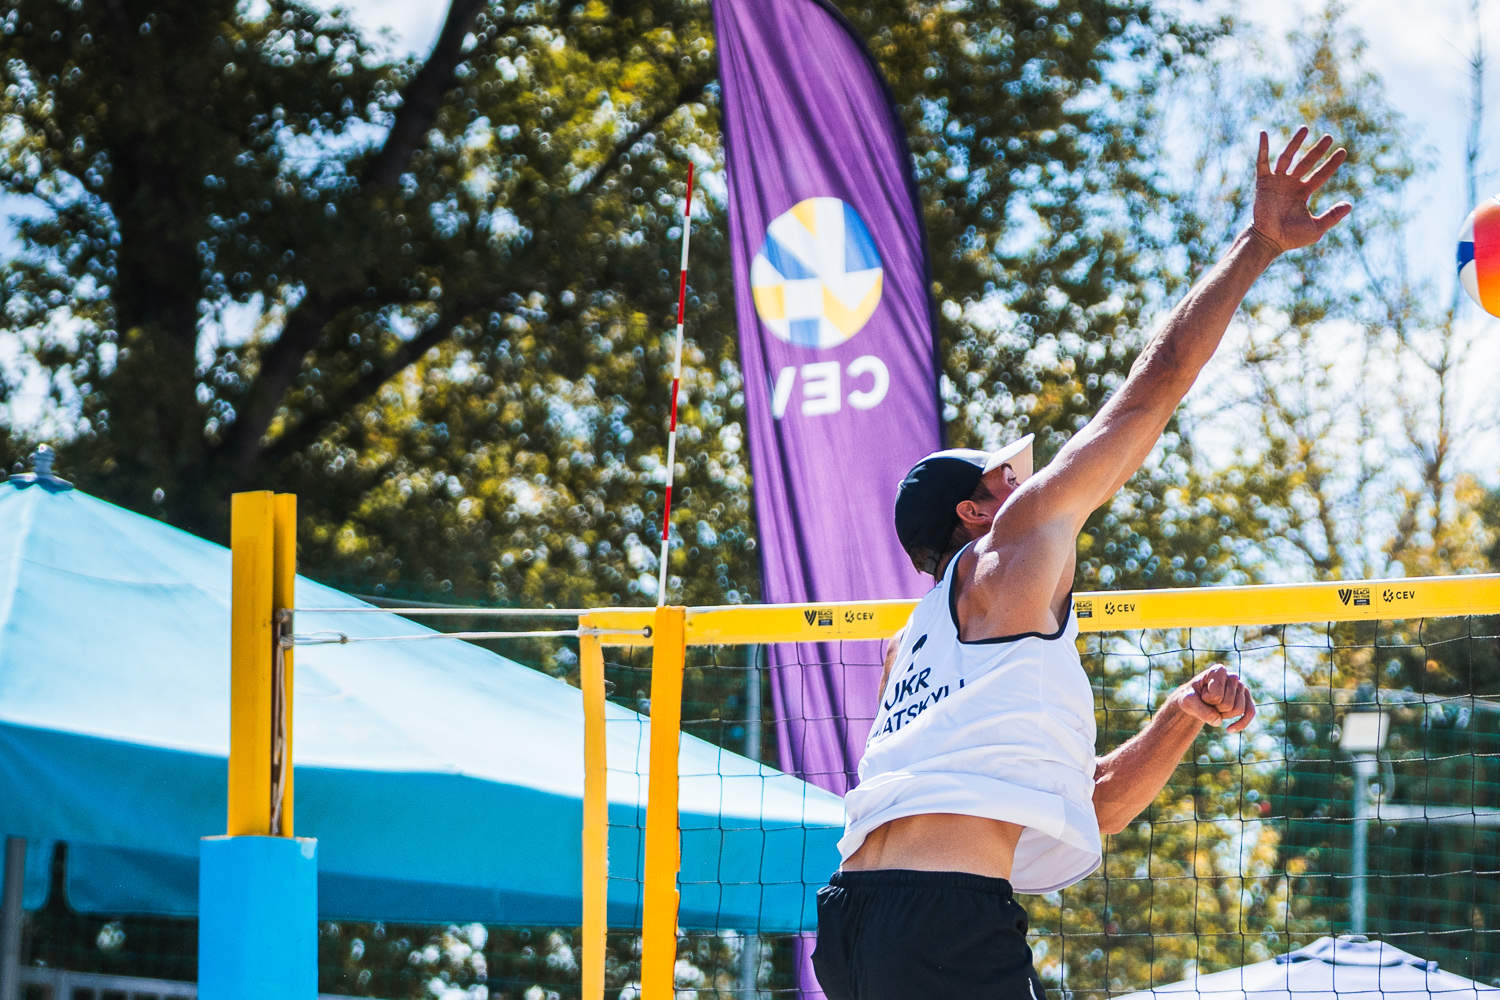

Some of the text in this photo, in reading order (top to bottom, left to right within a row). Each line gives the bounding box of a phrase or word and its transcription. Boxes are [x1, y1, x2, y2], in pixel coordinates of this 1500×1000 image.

[1396, 591, 1415, 600] CEV
[1117, 604, 1136, 612] CEV
[856, 612, 874, 620] CEV
